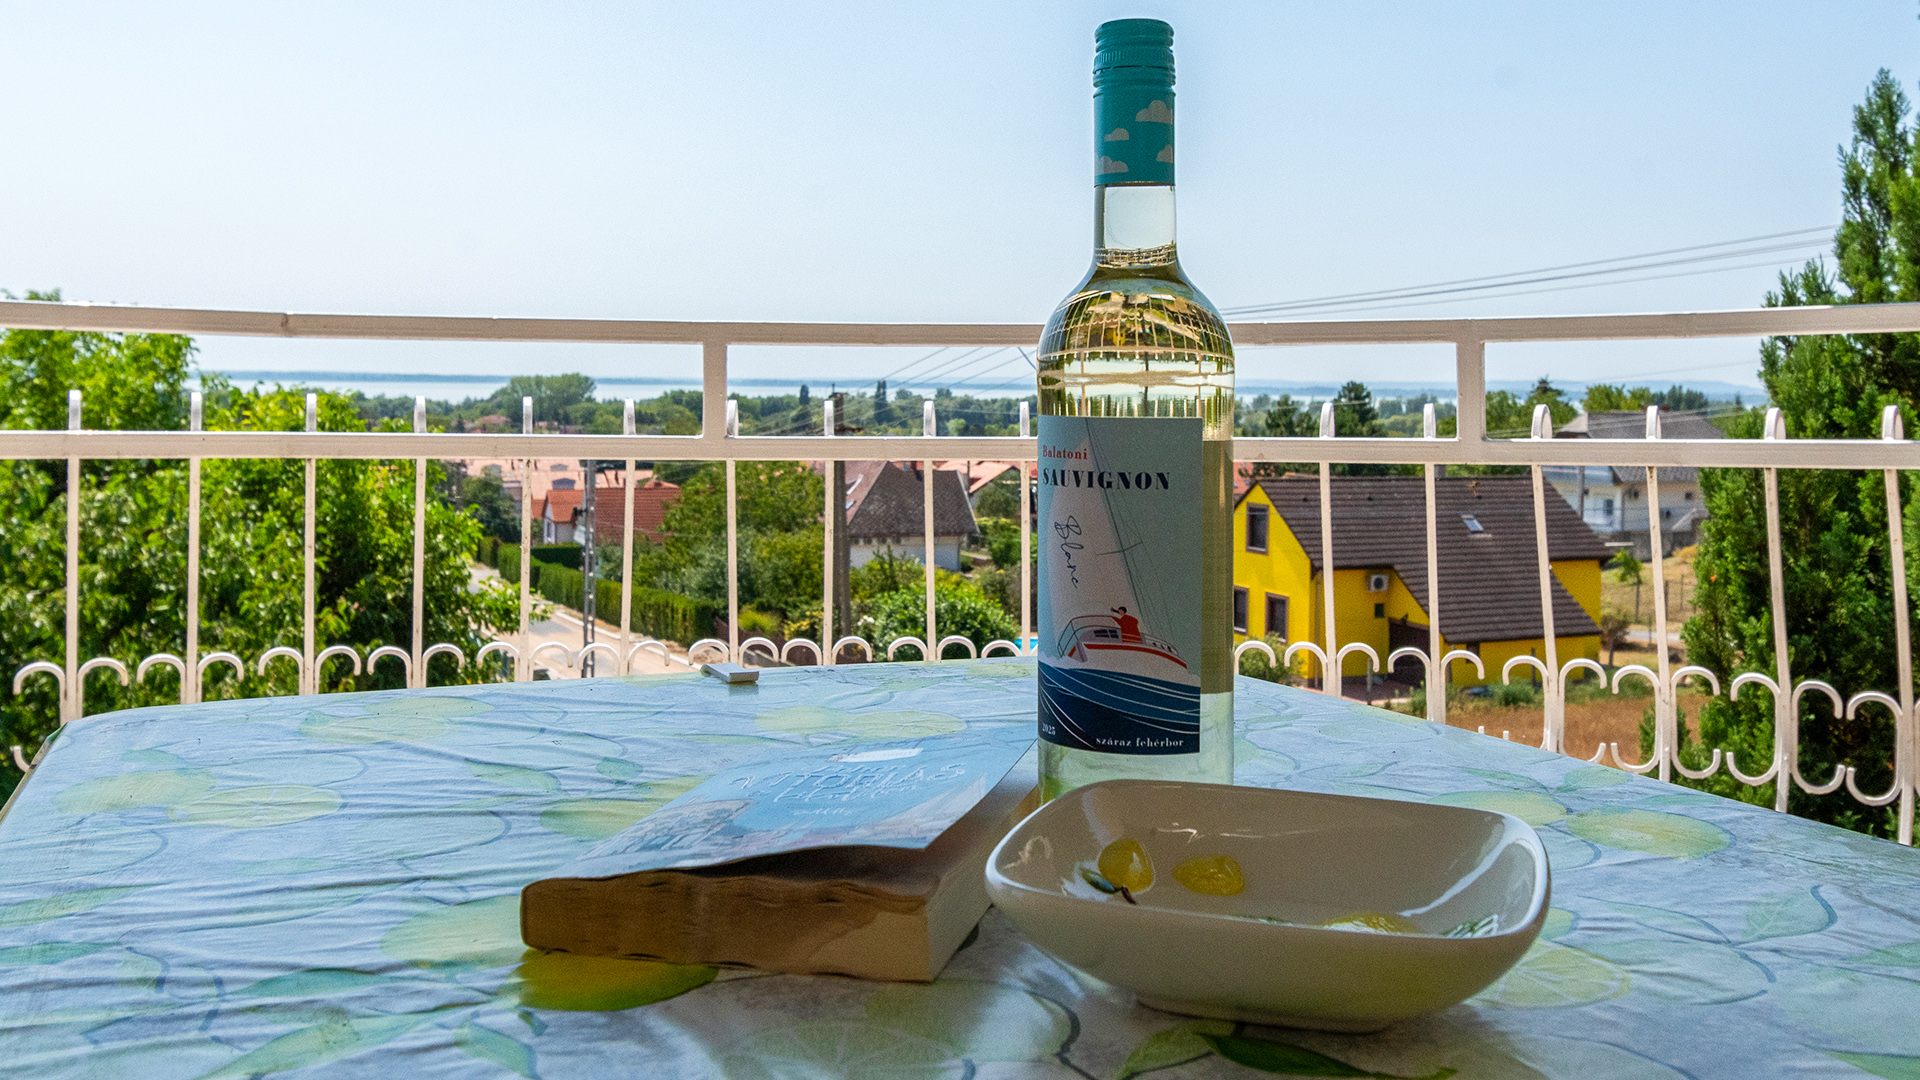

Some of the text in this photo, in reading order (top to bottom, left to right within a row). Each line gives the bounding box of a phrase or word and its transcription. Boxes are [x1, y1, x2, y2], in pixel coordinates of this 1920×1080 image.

[1042, 445, 1087, 460] Balatoni
[1042, 467, 1171, 491] SAUVIGNON
[1054, 515, 1085, 589] Blanc
[1095, 736, 1184, 748] száraz fehérbor
